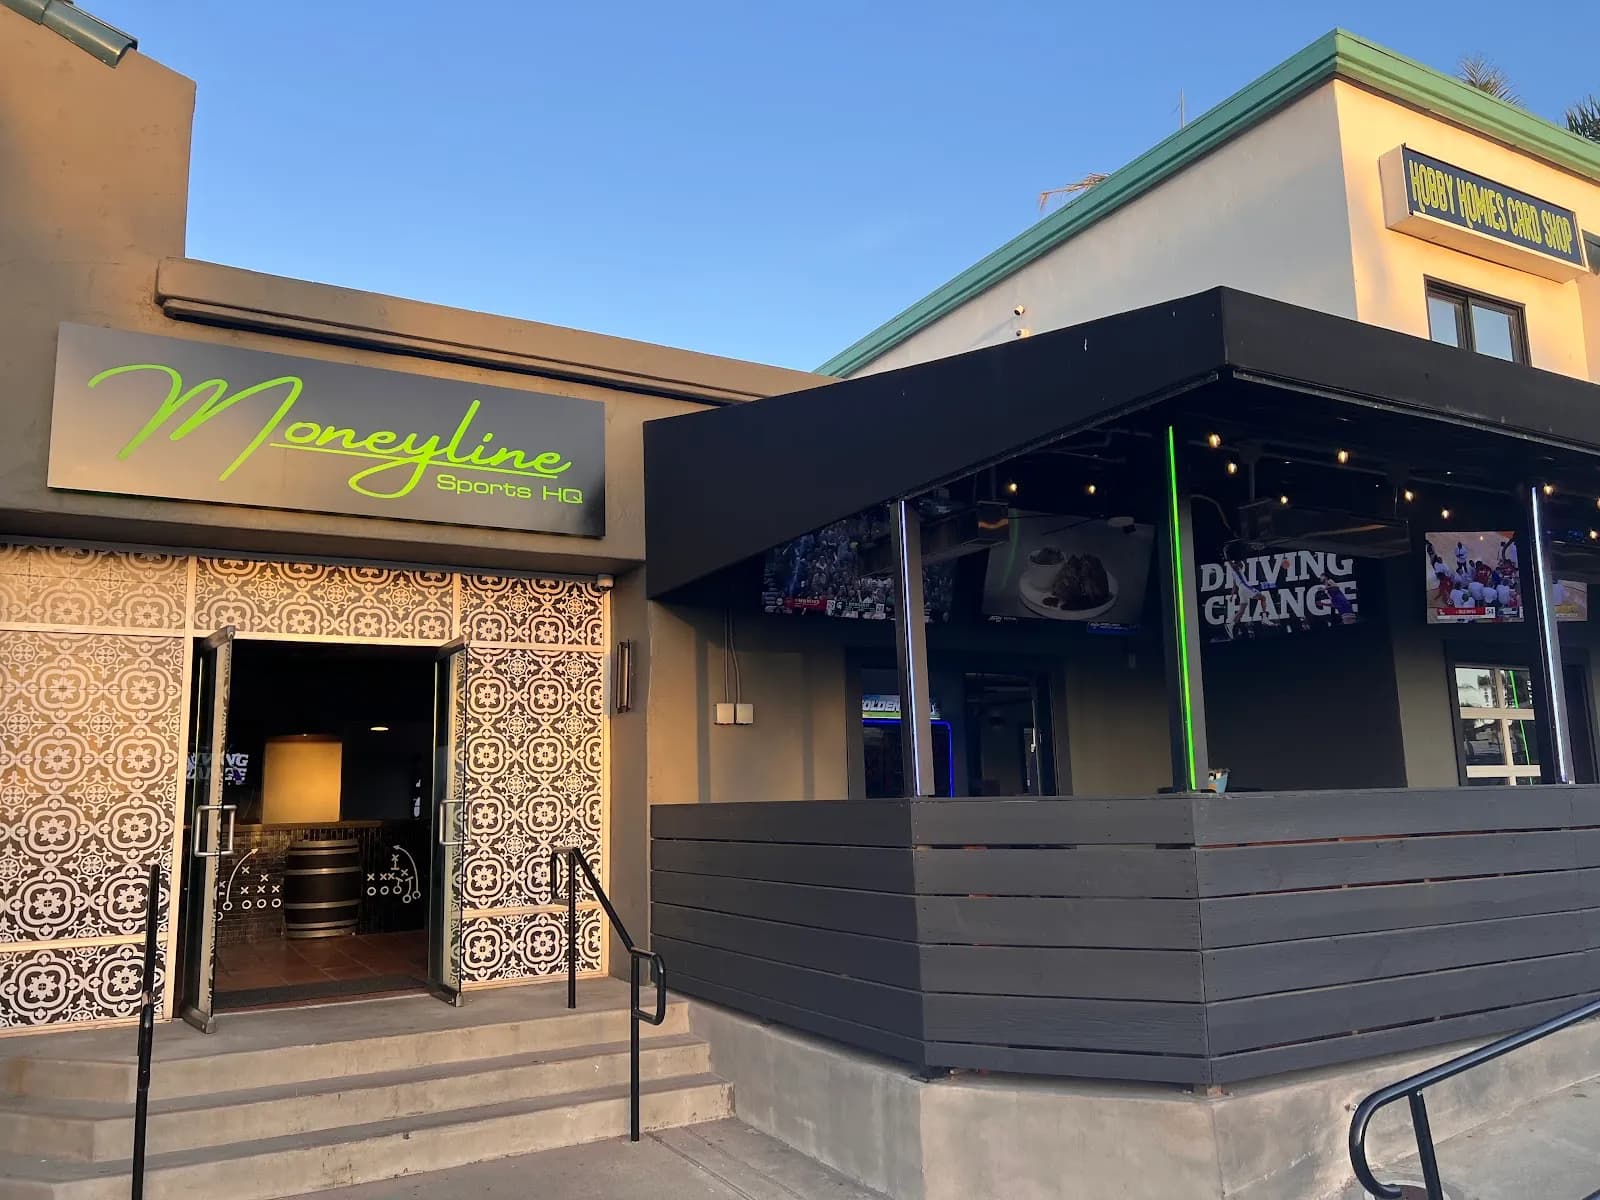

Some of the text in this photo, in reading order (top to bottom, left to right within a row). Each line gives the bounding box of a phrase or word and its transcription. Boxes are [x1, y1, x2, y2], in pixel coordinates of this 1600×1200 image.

[1408, 159, 1573, 254] HOBBY HOMIES CARD SHOP
[88, 364, 572, 499] Moneyline
[436, 473, 583, 504] Sports HQ
[862, 699, 901, 712] OLDEN
